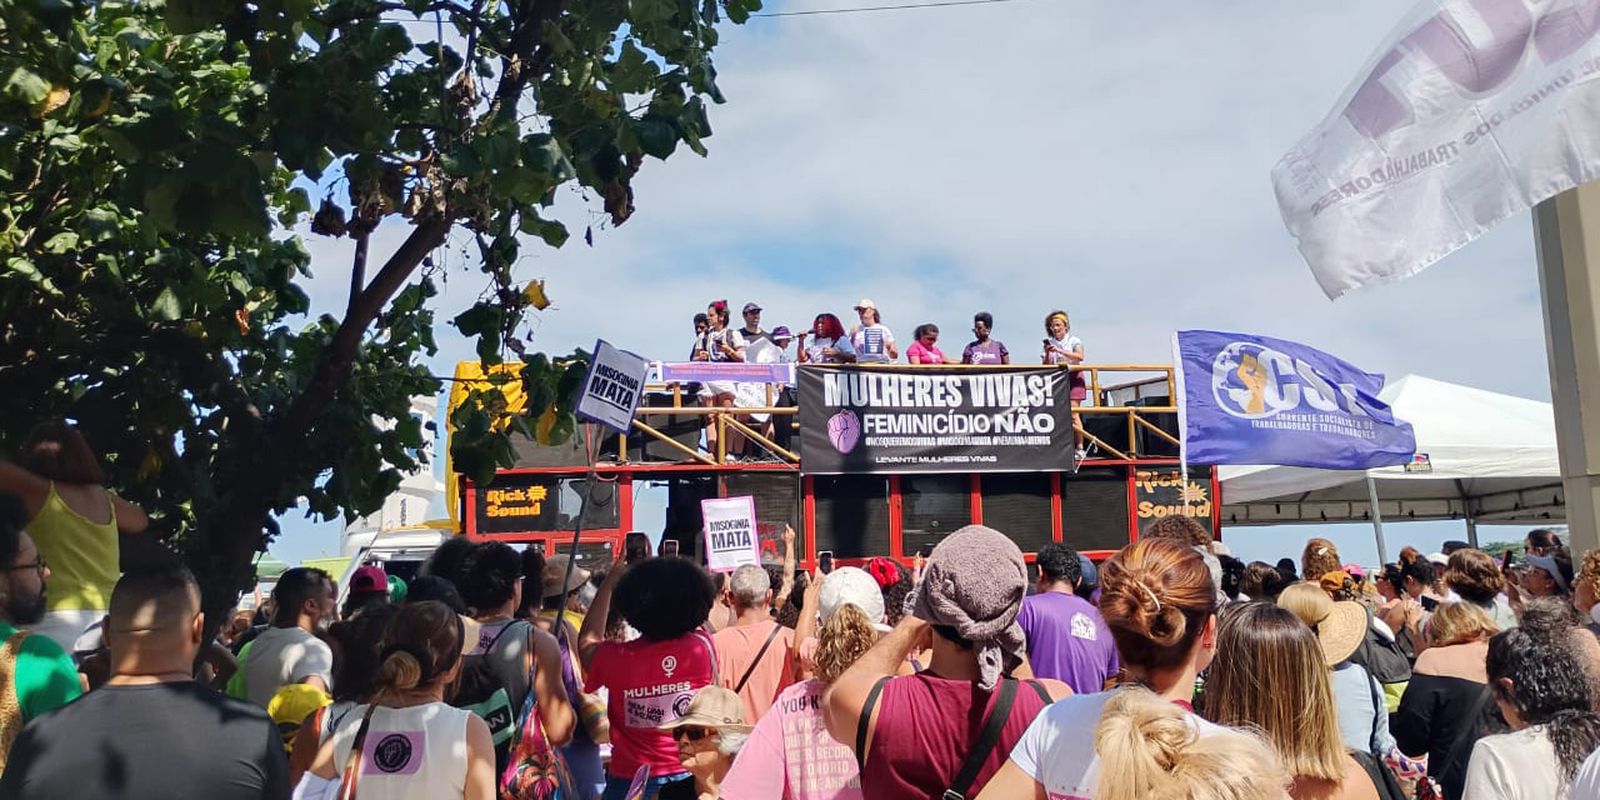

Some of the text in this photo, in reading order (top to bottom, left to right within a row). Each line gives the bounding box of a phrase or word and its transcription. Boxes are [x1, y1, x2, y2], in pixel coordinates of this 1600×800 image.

[595, 363, 639, 392] MISOGINIA
[589, 375, 635, 409] MATA
[824, 373, 1054, 407] MULHERES VIVAS!
[863, 406, 1055, 434] FEMINICÍDIO NÃO
[918, 455, 969, 463] MULHERES
[1135, 471, 1184, 493] Rick
[486, 489, 525, 505] Rick
[486, 502, 541, 517] Sound
[1138, 501, 1211, 518] Sound
[709, 518, 750, 532] MISOGINIA
[711, 531, 752, 549] MATA
[624, 681, 692, 698] MULHERES
[783, 695, 807, 714] YOU
